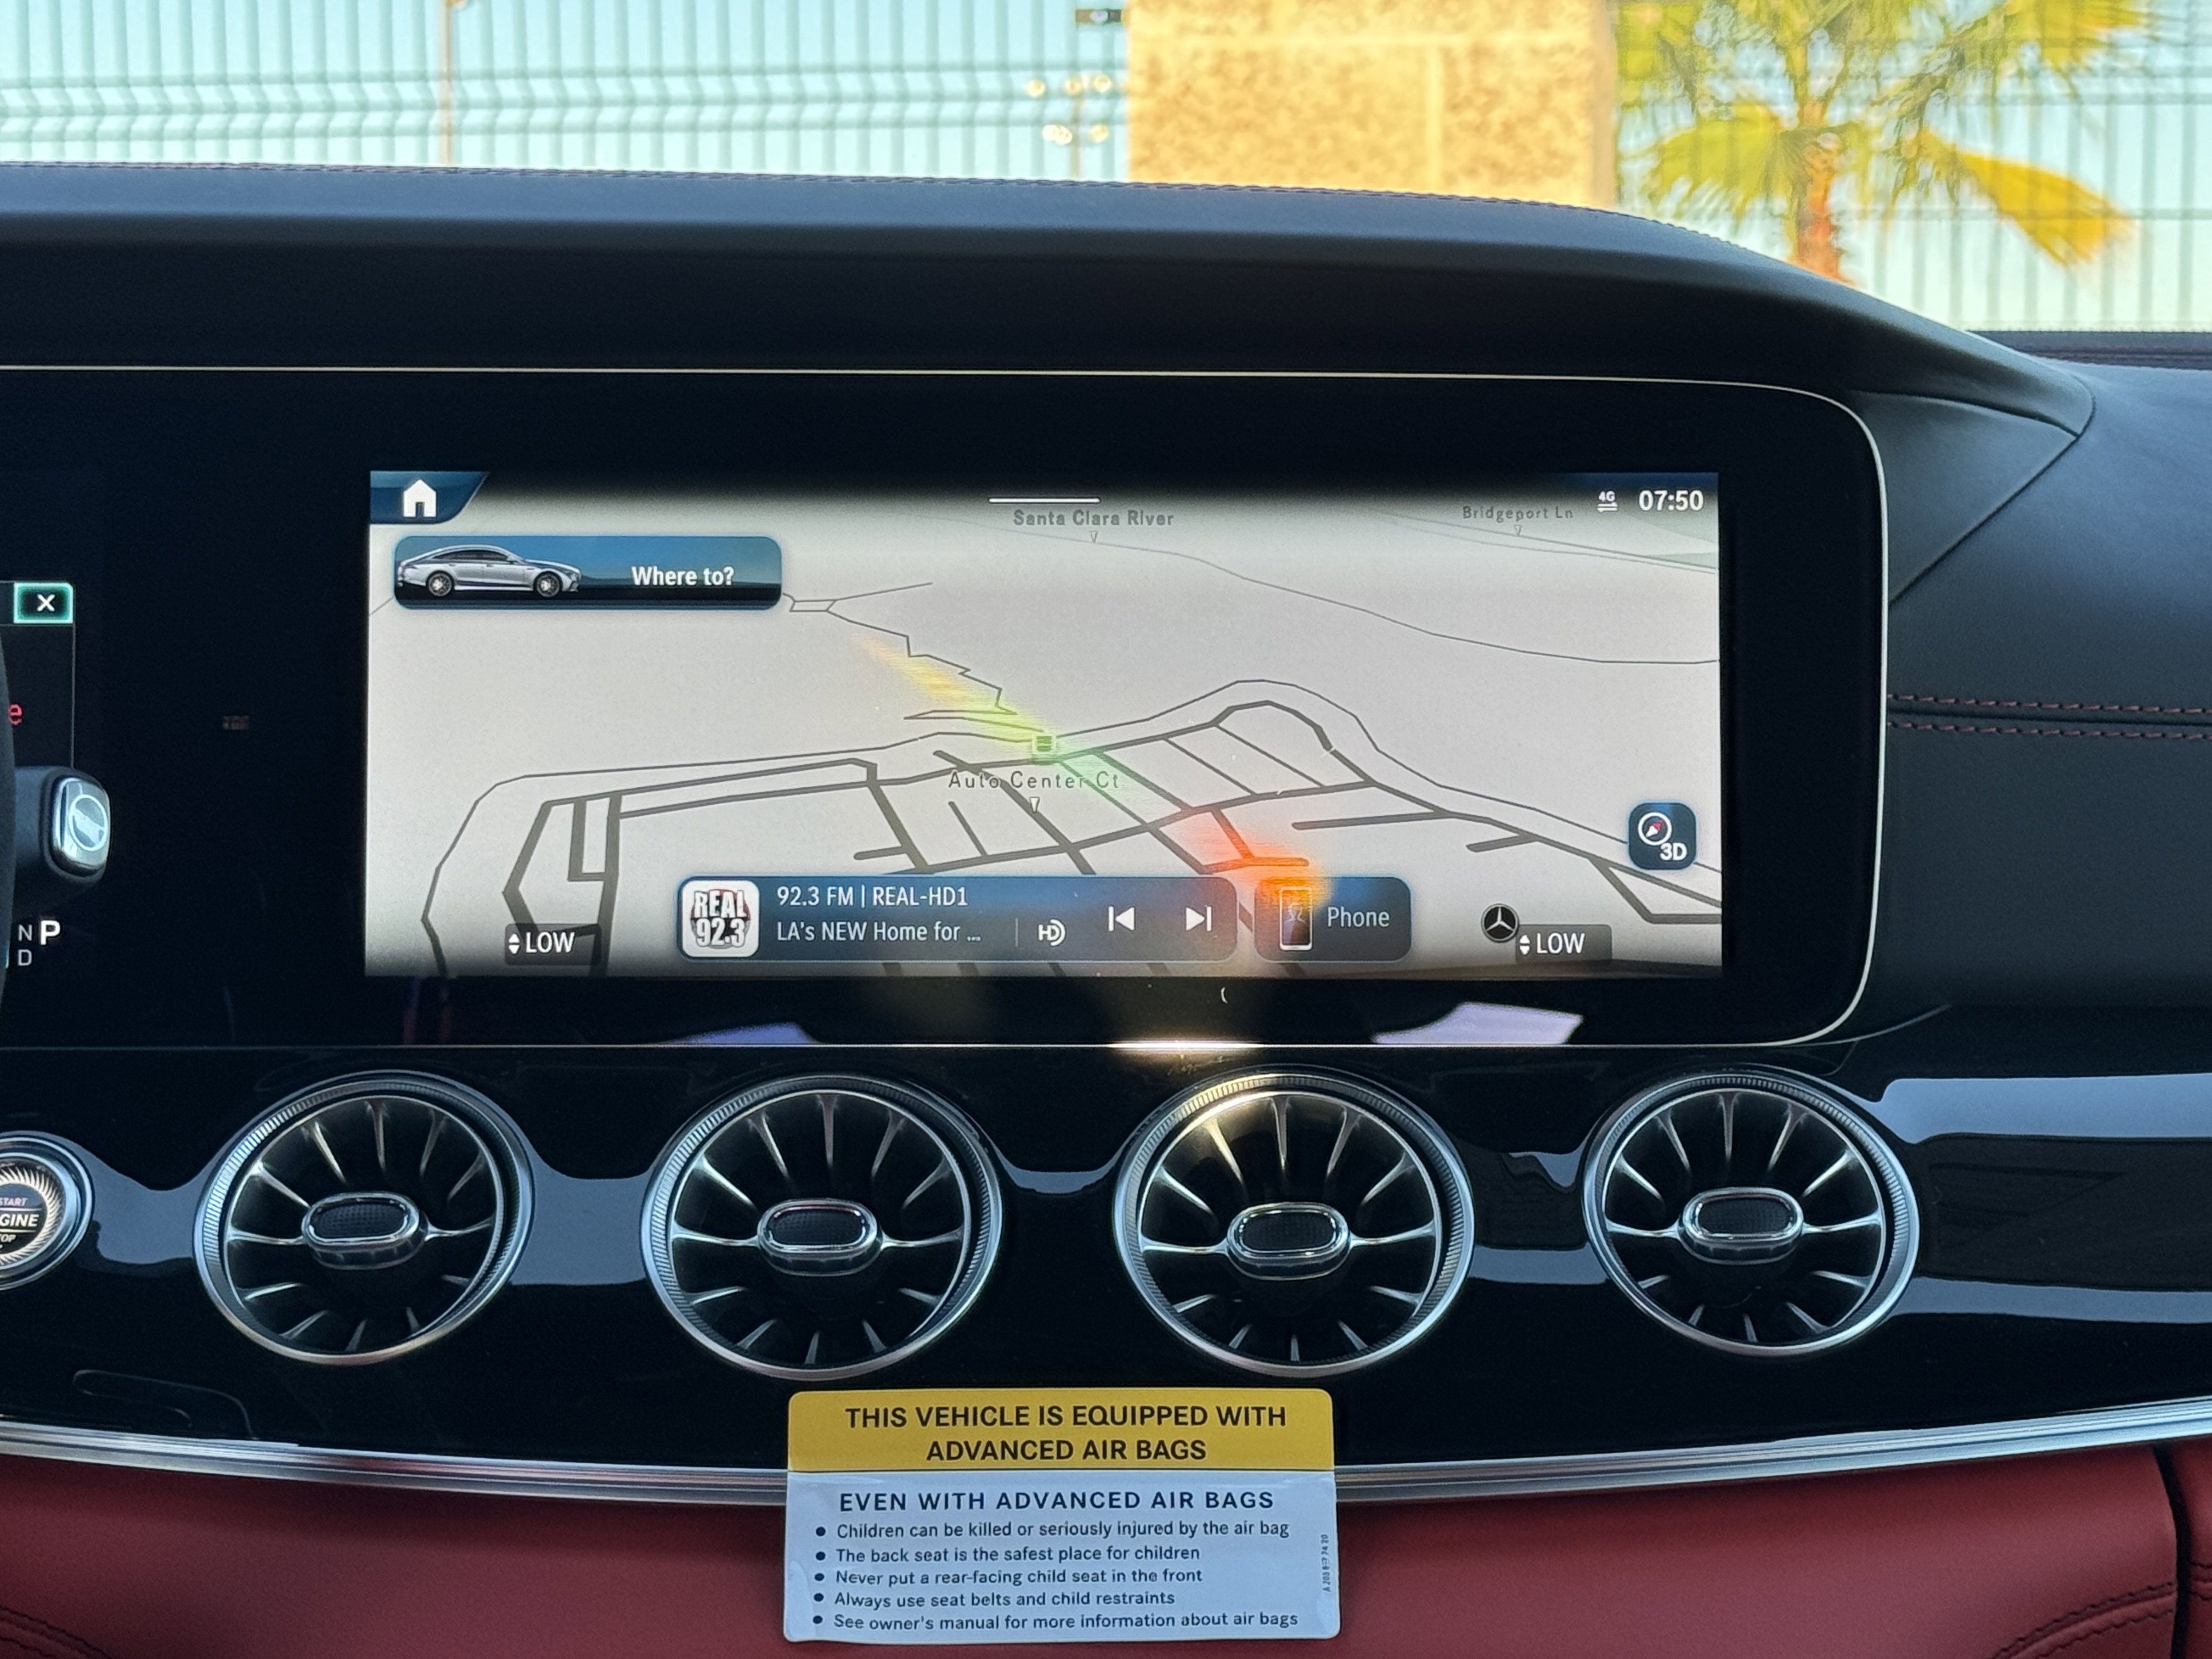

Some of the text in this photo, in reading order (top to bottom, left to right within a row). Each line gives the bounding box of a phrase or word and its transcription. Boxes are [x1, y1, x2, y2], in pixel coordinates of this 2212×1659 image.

[1598, 490, 1616, 503] 4G
[1639, 490, 1704, 511] 07:50
[1013, 509, 1174, 526] Santa Clara River
[1463, 506, 1573, 522] Bridgeport Ln
[631, 566, 735, 585] Where to?
[949, 771, 1119, 788] Auto Center Ct
[1660, 842, 1688, 861] 3D
[693, 889, 747, 918] REAL
[777, 886, 820, 906] 92.3
[827, 886, 854, 906] FM
[873, 886, 968, 906] REAL-HD1
[1328, 906, 1390, 927] Phone
[18, 919, 61, 945] N P
[696, 918, 746, 947] 92.3
[777, 922, 815, 941] LA's
[822, 922, 867, 941] NEW
[873, 922, 928, 941] Home
[934, 921, 961, 941] for
[525, 932, 575, 953] LOW
[1536, 932, 1585, 953] LOW
[18, 949, 32, 967] D
[845, 1406, 1286, 1427] THIS VEHICLE IS EQUIPPED WITH
[926, 1440, 1206, 1460] ADVANCED AIR BAGS
[840, 1491, 1274, 1511] EVEN WITH ADVANCED AIR BAGS
[837, 1520, 1290, 1538] Children can be killed or seriously injured by the air bag
[836, 1545, 1200, 1564] The back seat is the safest place for children
[836, 1568, 1203, 1587] Never put a rear-facing child seat in the front
[834, 1591, 1175, 1610] Always use seat belts and child restraints
[834, 1611, 1299, 1630] See owner's manual for more information about air bags
